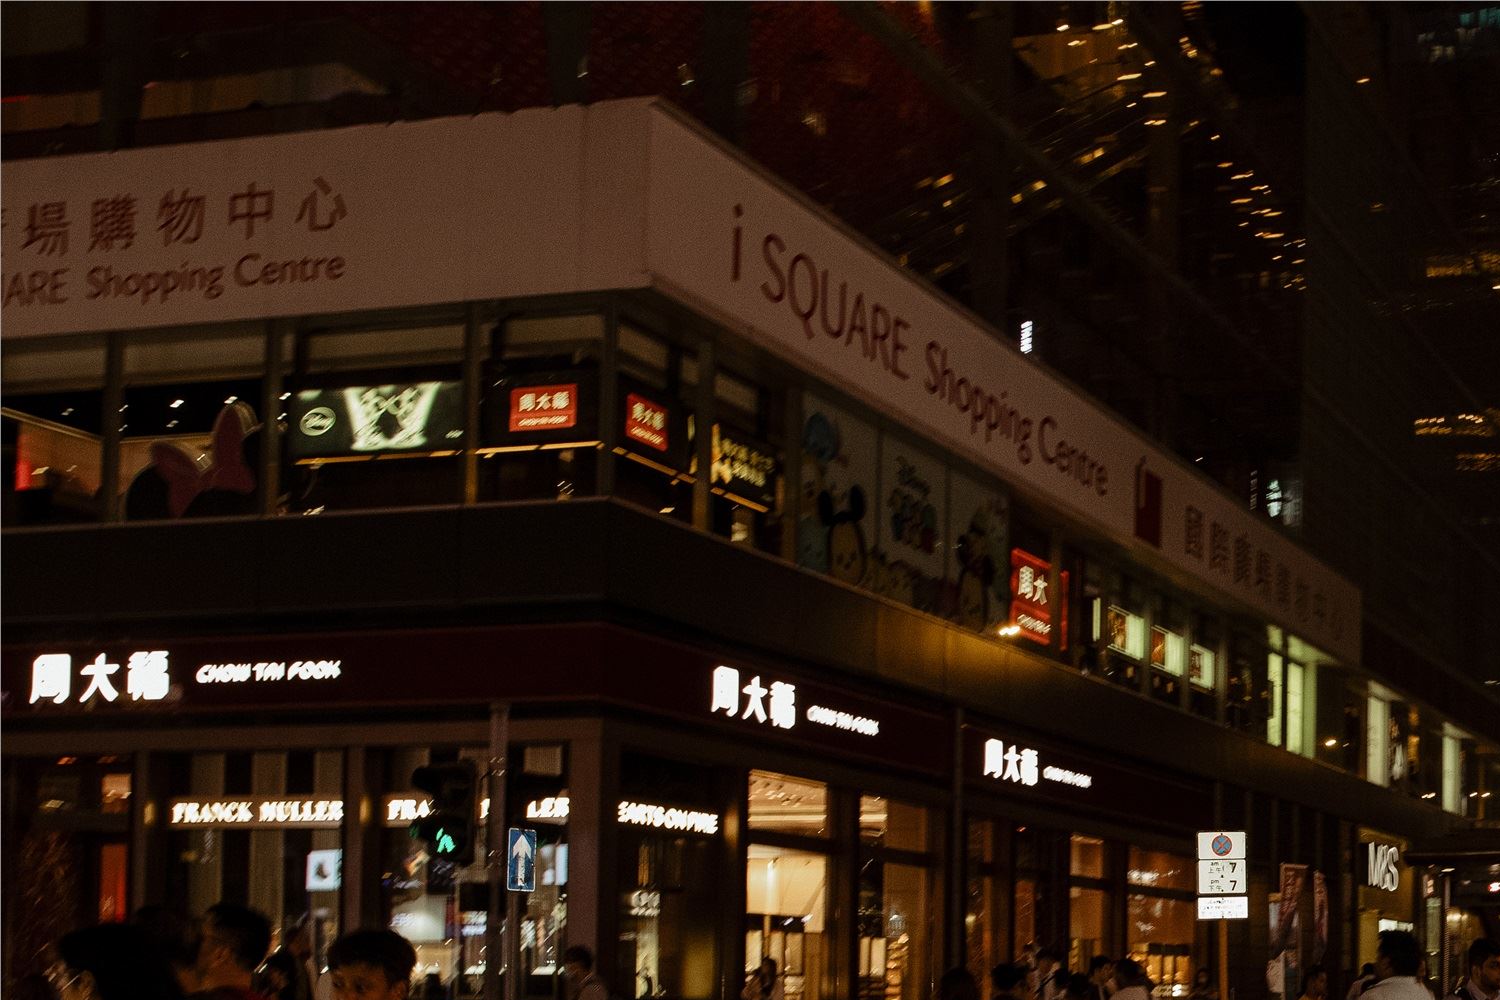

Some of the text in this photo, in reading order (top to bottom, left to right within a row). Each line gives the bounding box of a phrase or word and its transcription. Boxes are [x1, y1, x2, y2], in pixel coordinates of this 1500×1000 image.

[0, 177, 347, 256] 場購物中心
[0, 252, 346, 307] ARE Shopping Centre
[761, 233, 910, 380] SQUARE
[925, 340, 1033, 466] Shopping
[1038, 415, 1108, 496] Centre
[1018, 565, 1049, 606] 周大
[196, 664, 251, 683] CHOW
[287, 660, 341, 680] FOOK
[172, 801, 344, 824] FRANCK MULLER
[387, 799, 434, 821] FRA
[1229, 862, 1237, 873] 7
[1229, 880, 1238, 891] 7
